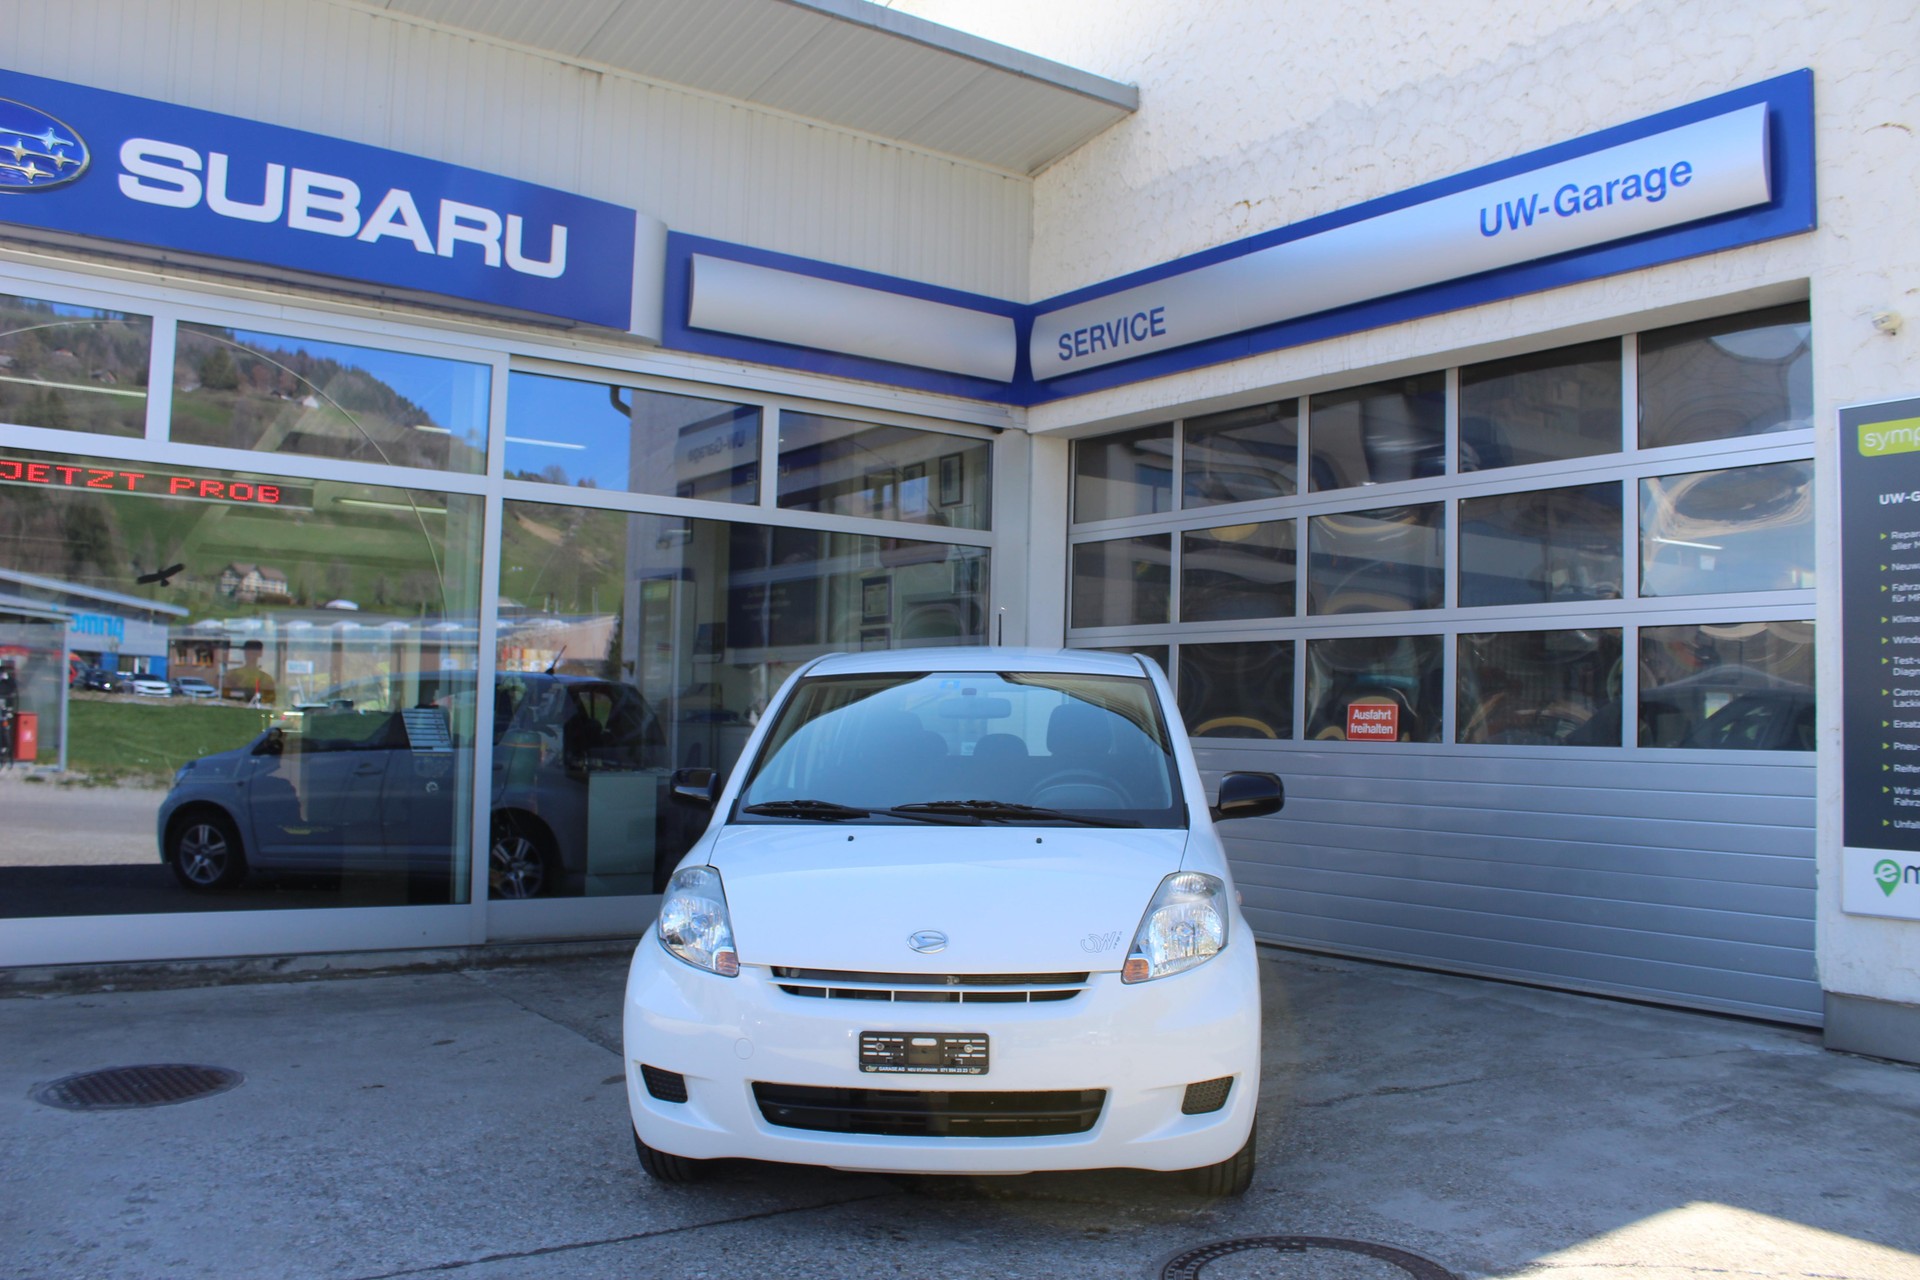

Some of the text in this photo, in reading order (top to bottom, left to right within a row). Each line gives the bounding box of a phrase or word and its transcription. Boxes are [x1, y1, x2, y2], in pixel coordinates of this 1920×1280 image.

[117, 137, 568, 279] SUBARU
[1479, 160, 1693, 238] UW-Garage
[1058, 306, 1167, 361] SERVICE
[0, 461, 280, 503] JETZT PROB
[1350, 722, 1394, 734] freihalten
[1353, 709, 1392, 720] Ausfahrt
